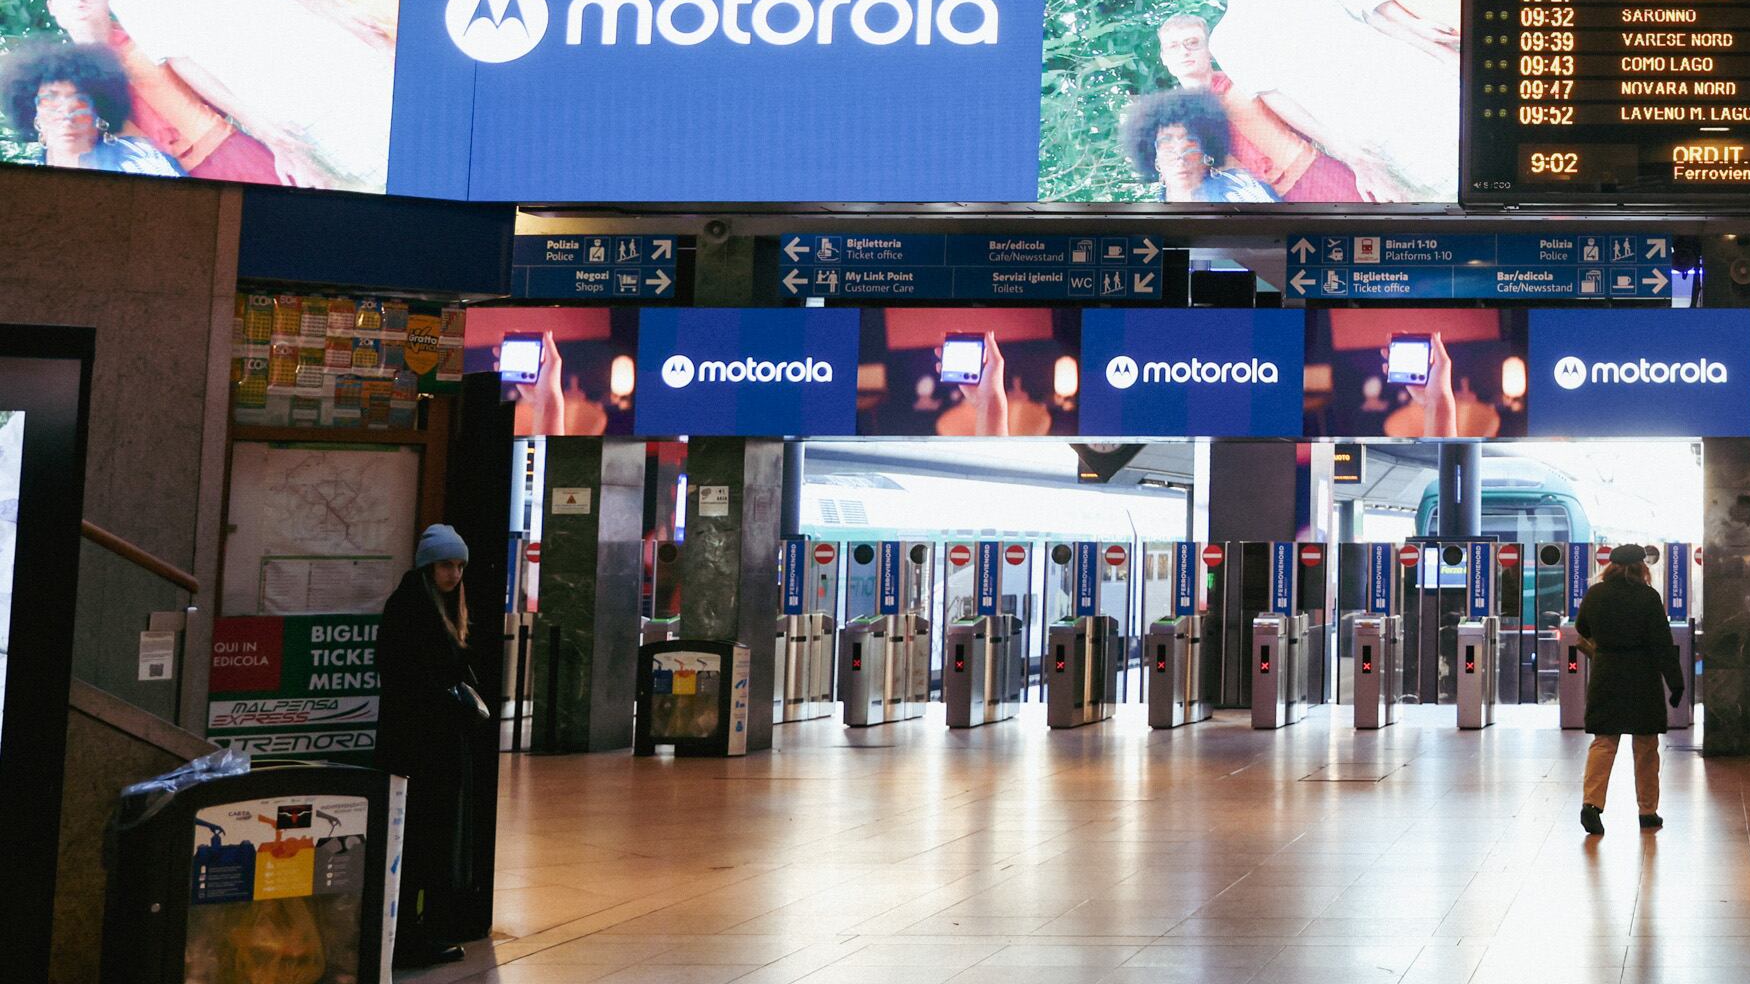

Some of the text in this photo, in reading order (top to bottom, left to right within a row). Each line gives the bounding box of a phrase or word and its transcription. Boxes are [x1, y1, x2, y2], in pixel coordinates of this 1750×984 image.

[1521, 8, 1574, 27] 09:32
[1622, 9, 1697, 23] SARONNO
[1520, 32, 1574, 51] 09:39
[1622, 34, 1687, 47] VARESE
[1692, 34, 1733, 47] NORD
[1520, 56, 1574, 75] 09:43
[1621, 58, 1666, 72] COMO
[1671, 58, 1714, 72] LAGO
[1520, 80, 1573, 99] 09:47
[1621, 82, 1688, 96] NOVARA
[1695, 82, 1736, 96] NORD
[1519, 106, 1573, 125] 09:52
[1621, 107, 1685, 121] LAVENO
[1690, 107, 1706, 121] M.
[1531, 152, 1578, 174] 9:02
[547, 240, 579, 251] Polizia
[847, 238, 902, 250] Biglietteria
[989, 240, 1045, 251] Bar/edicola
[1385, 239, 1437, 249] Binari 1-10
[1540, 239, 1573, 249] Polizia
[546, 251, 575, 261] Police
[846, 250, 903, 260] Ticket office
[1385, 251, 1452, 261] Platforms 1-10
[1540, 251, 1568, 261] Police
[576, 270, 609, 282] Negozi
[845, 271, 914, 283] My Link Point
[993, 271, 1063, 283] Servizi igienici
[1353, 271, 1409, 283] Biglietteria
[1497, 271, 1553, 282] Bar/edicola
[575, 282, 604, 293] Shops
[845, 283, 914, 294] Customer Care
[992, 283, 1024, 294] Toilets
[1070, 277, 1093, 289] WC
[1353, 282, 1410, 293] Ticket office
[698, 358, 833, 384] motorola
[1142, 358, 1279, 384] motorola
[1591, 358, 1728, 384] motorola
[214, 641, 257, 653] QUI IN
[213, 655, 269, 666] EDICOLA
[231, 699, 339, 714] MALPENSA
[211, 712, 311, 727] EXPRESS
[234, 732, 374, 752] TRENORD
